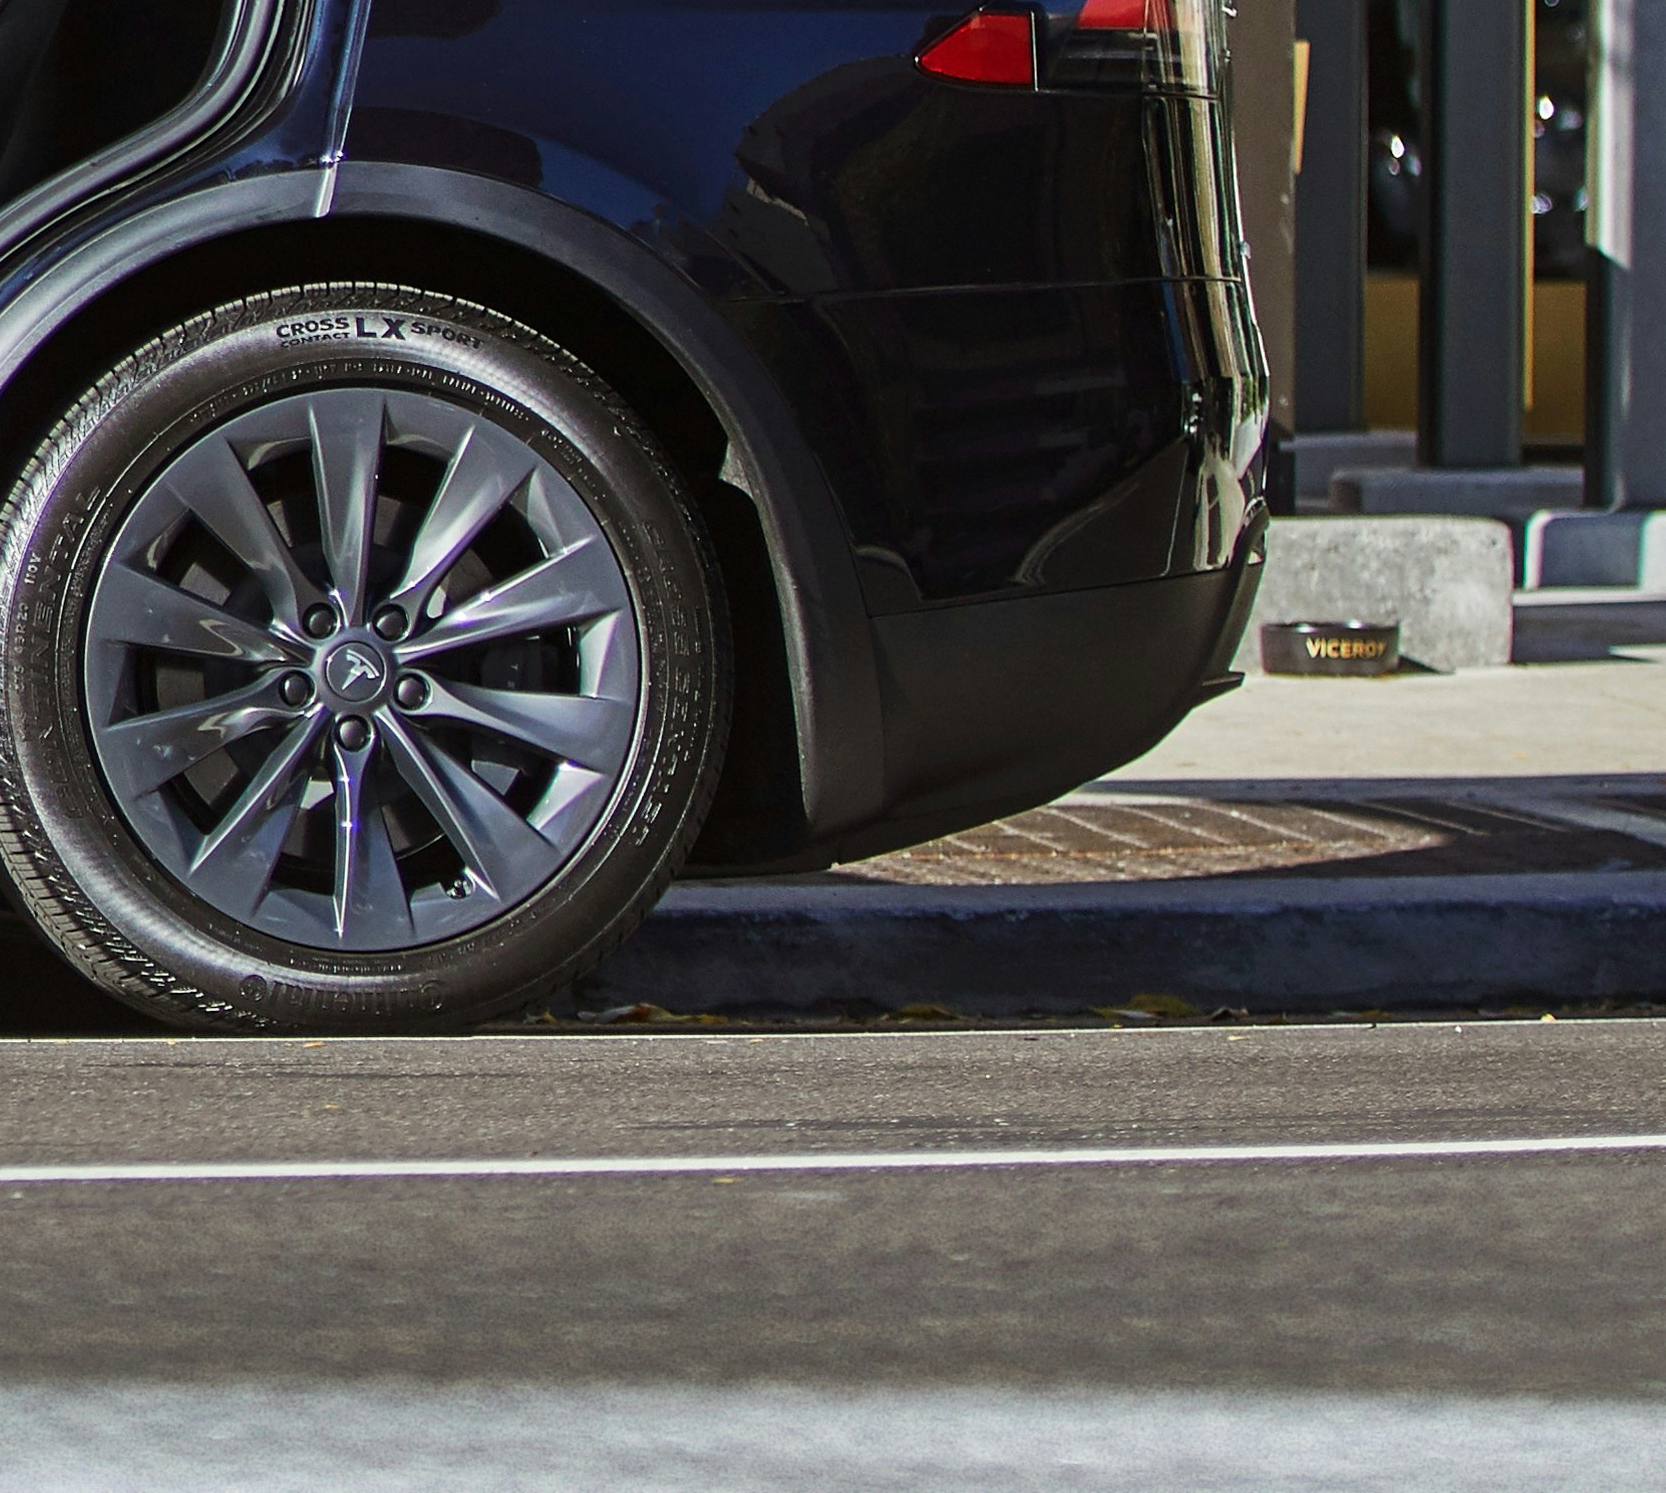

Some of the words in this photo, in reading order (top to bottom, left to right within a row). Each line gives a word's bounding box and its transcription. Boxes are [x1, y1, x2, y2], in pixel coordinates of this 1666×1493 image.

[275, 316, 350, 339] CROSS
[355, 316, 407, 342] LX
[410, 320, 485, 350] SPORT
[279, 332, 351, 349] CONTACT
[1305, 636, 1387, 659] VICEROY
